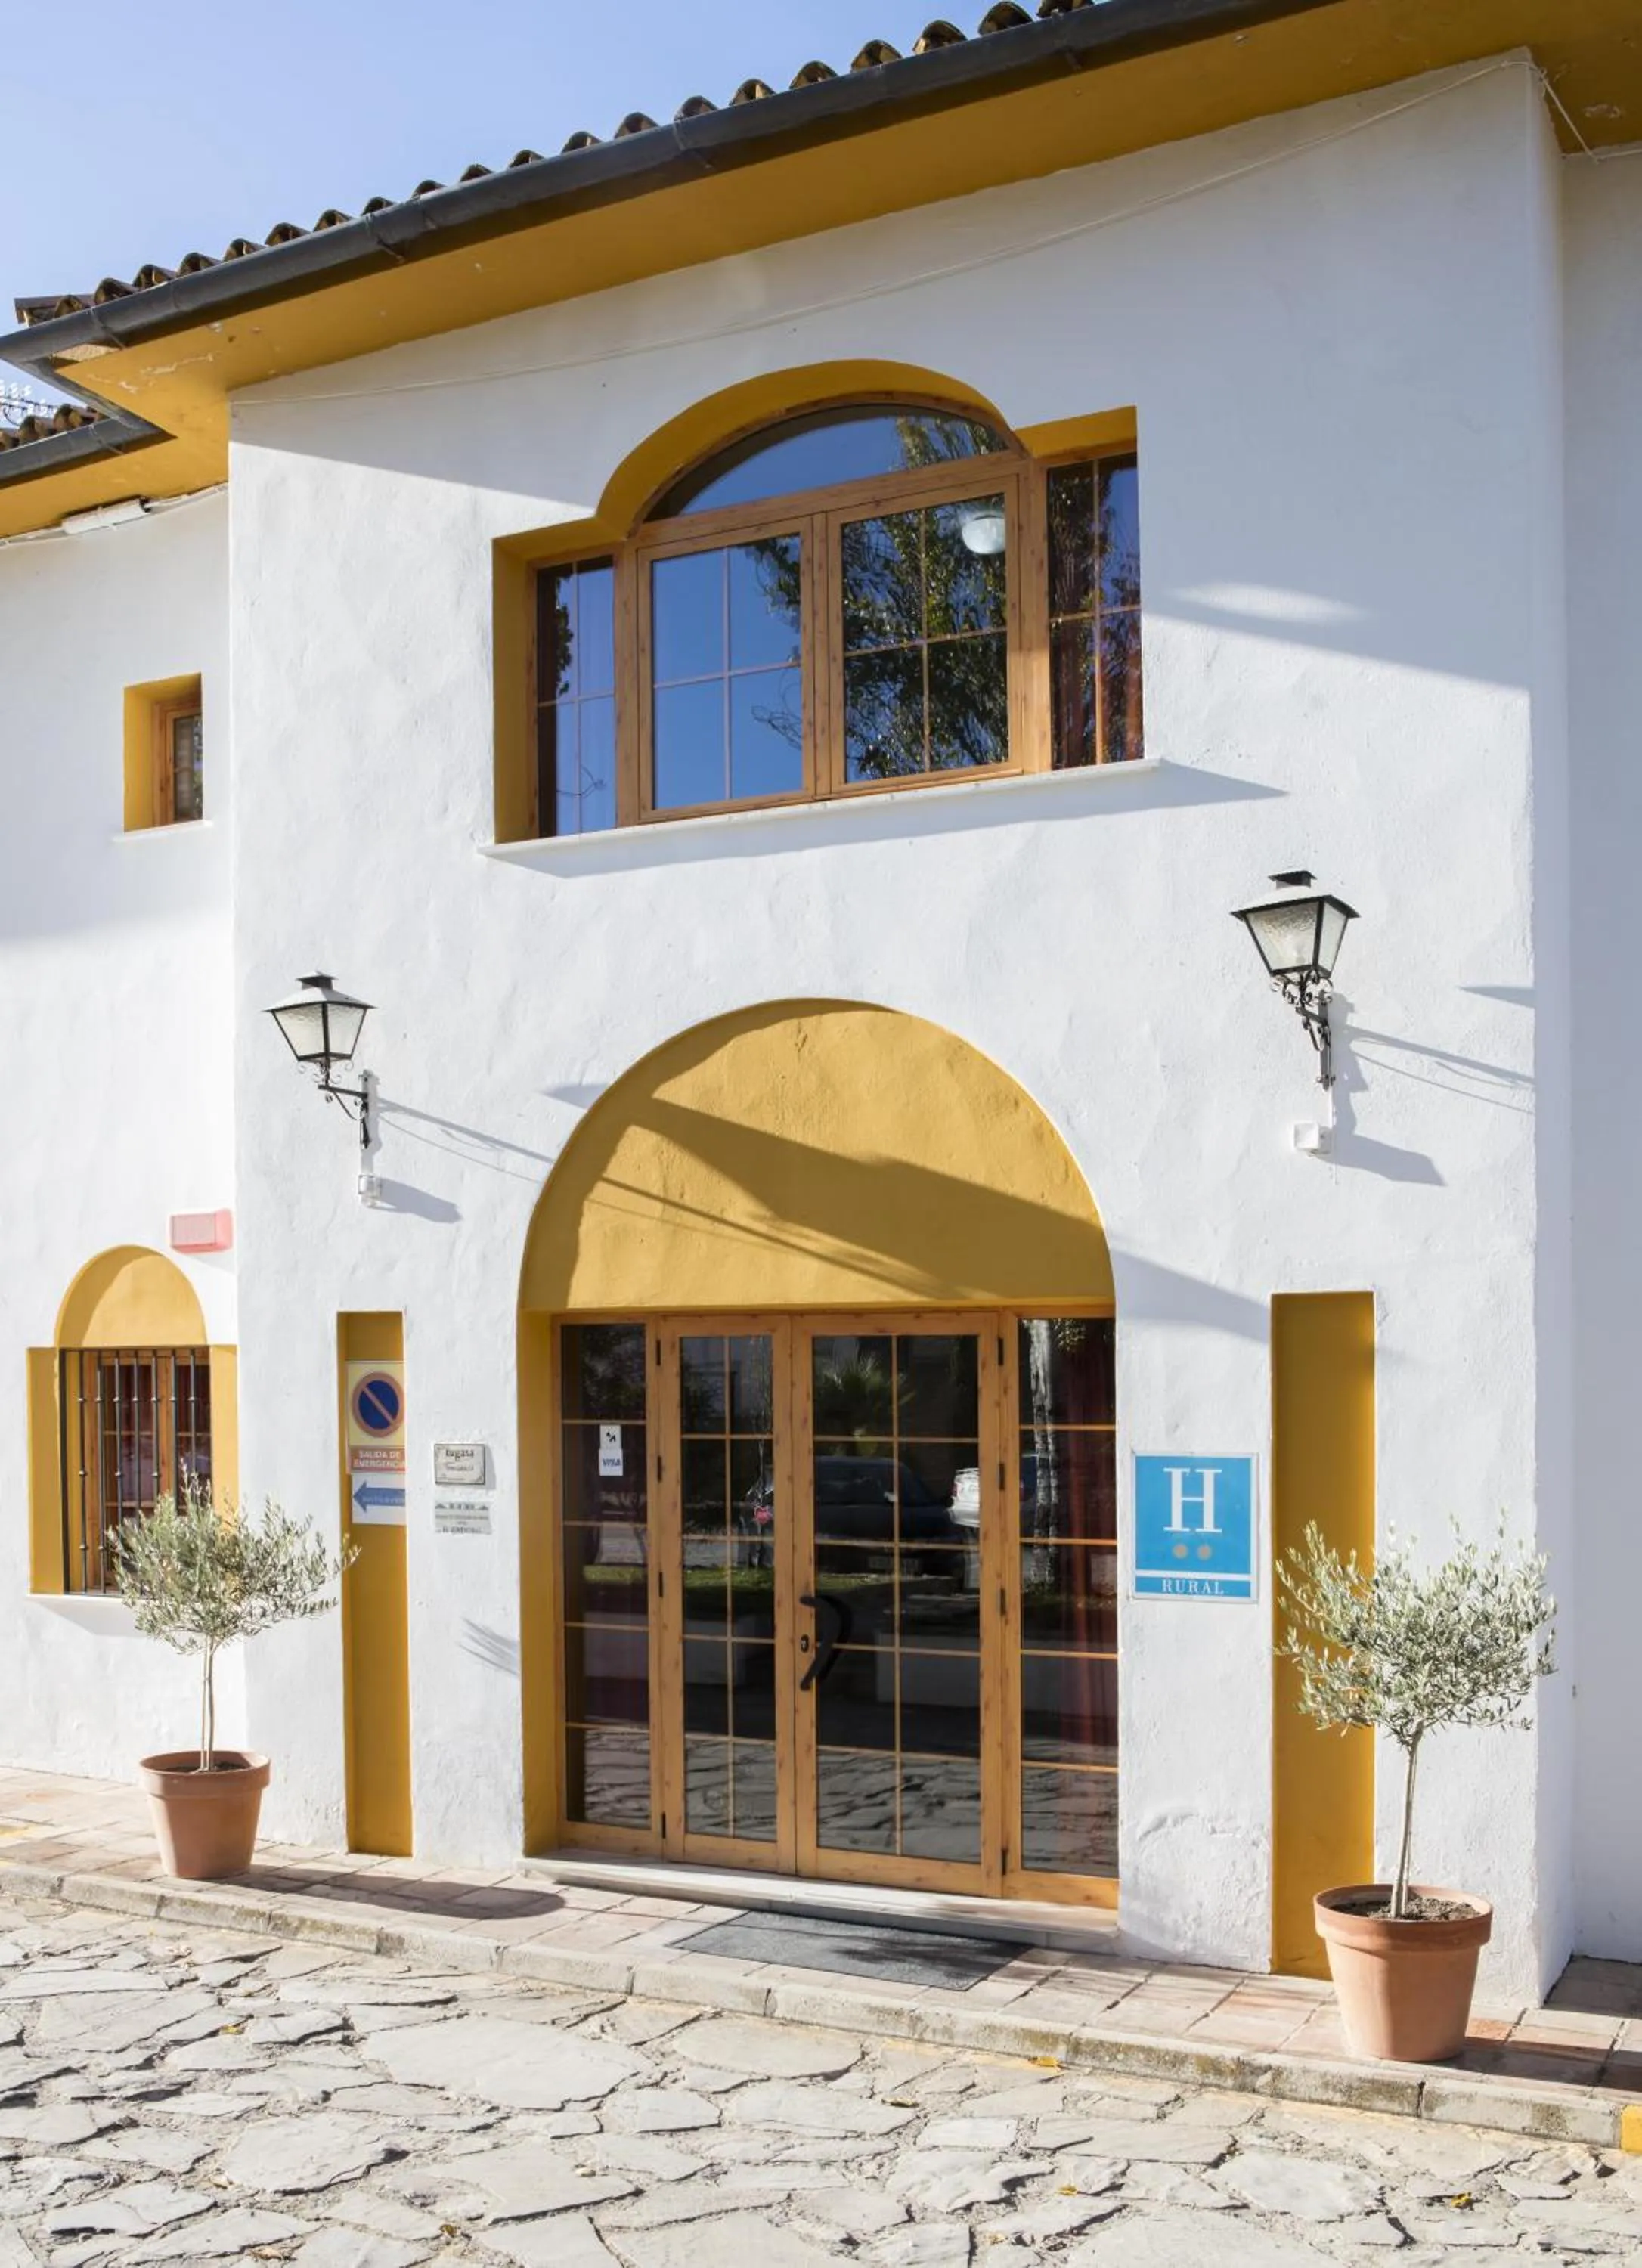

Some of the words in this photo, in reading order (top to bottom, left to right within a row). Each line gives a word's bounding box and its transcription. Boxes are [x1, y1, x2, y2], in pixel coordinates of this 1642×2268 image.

[389, 1451, 400, 1459] DE
[603, 1458, 620, 1467] VISA
[1163, 1467, 1222, 1533] H
[1161, 1578, 1224, 1595] RURAL
